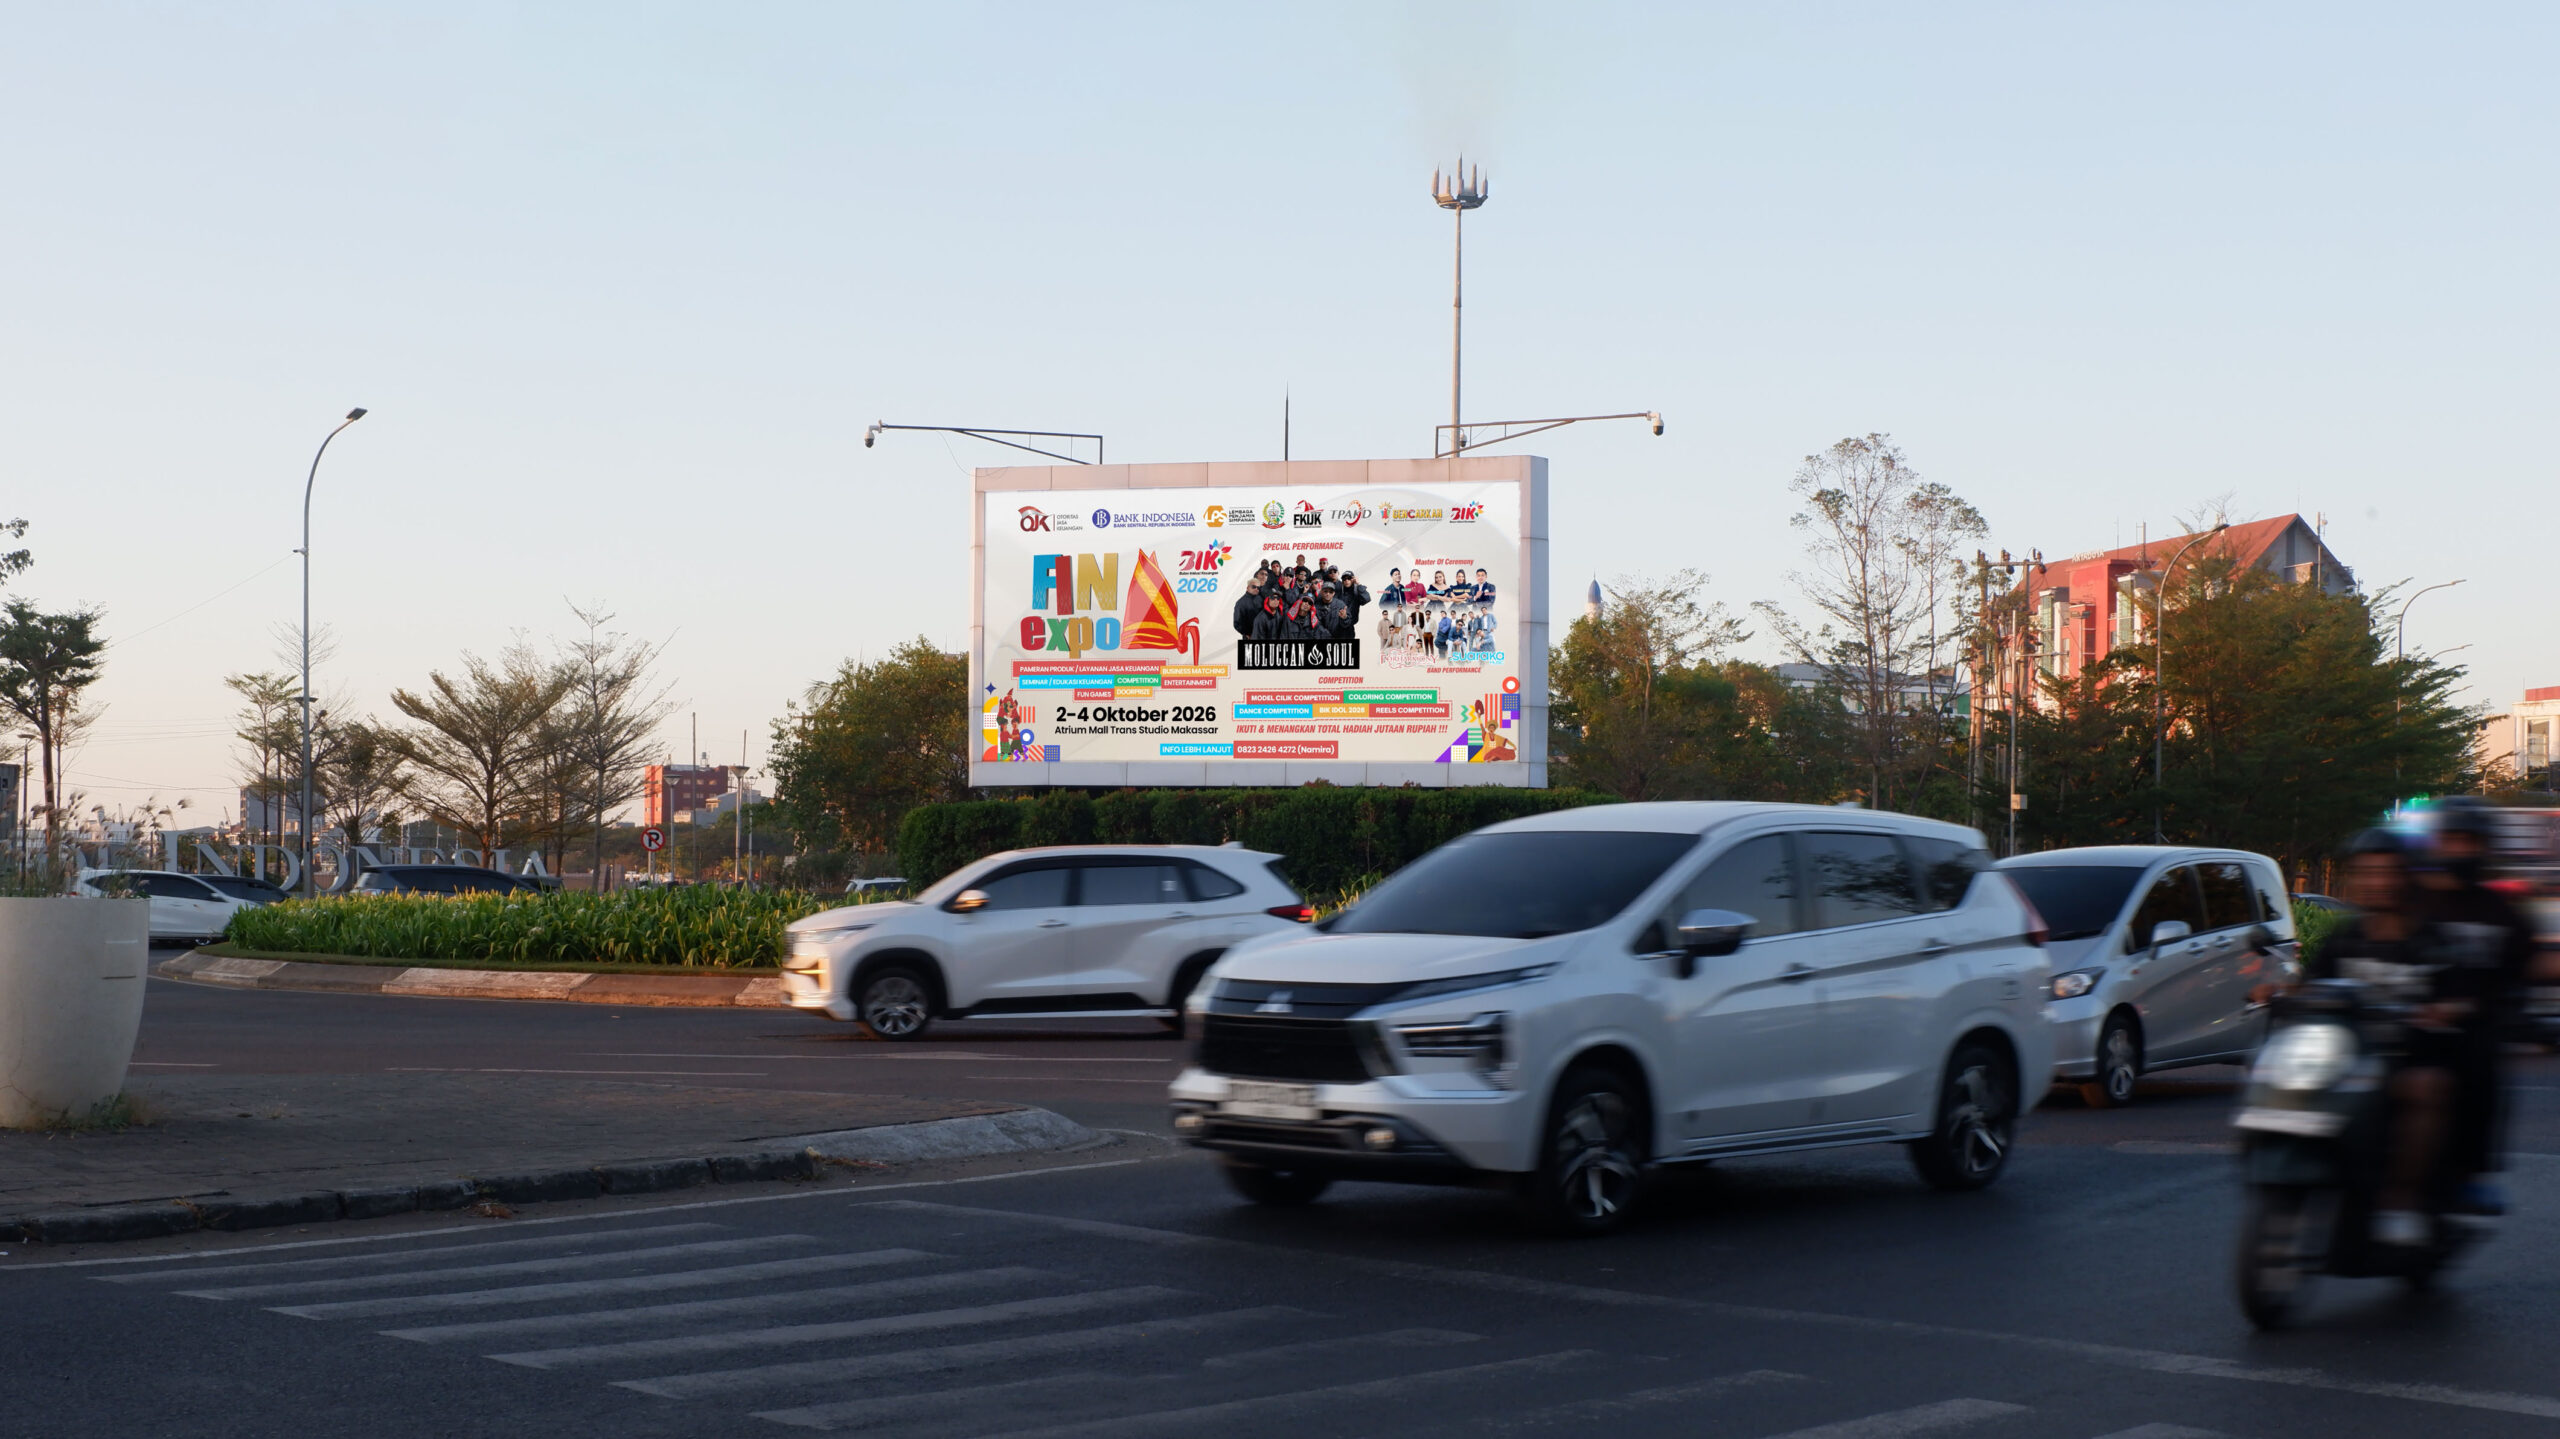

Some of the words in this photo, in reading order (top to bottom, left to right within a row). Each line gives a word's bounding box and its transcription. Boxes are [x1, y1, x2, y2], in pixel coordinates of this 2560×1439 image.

[1113, 513, 1140, 523] BANK
[1142, 512, 1196, 522] INDONESIA
[1204, 509, 1228, 522] LPS
[1330, 507, 1372, 520] TPAKD
[1392, 508, 1443, 519] GENCARKAN
[1450, 507, 1476, 520] BIK
[1020, 514, 1051, 532] OJK
[1262, 542, 1290, 551] SPECIAL
[1292, 541, 1344, 551] PERFORMANCE
[1179, 550, 1220, 571] BIK
[1415, 558, 1436, 566] Master
[1445, 558, 1474, 566] Ceremony
[1031, 552, 1119, 616] FIN
[1177, 577, 1218, 593] 2026
[1020, 615, 1121, 659] expo
[1244, 643, 1305, 667] MOLUCCAN
[1326, 643, 1355, 667] SOUL
[1318, 676, 1364, 685] COMPETITION
[1116, 688, 1151, 696] DOORPRIZE
[1348, 693, 1385, 701] COLORING
[1093, 706, 1169, 722] Oktober
[1172, 706, 1216, 722] 2026
[1054, 726, 1087, 734] Atrium
[1088, 726, 1109, 734] Mall
[1110, 726, 1137, 734] Trans
[1139, 725, 1169, 734] Studio
[1170, 725, 1219, 734] Makassar
[1236, 725, 1258, 733] IKUTI
[1258, 725, 1265, 733] &
[1267, 725, 1316, 733] MENANGKAN
[1318, 725, 1341, 733] TOTAL
[1342, 725, 1373, 733] HADIAH
[1374, 725, 1406, 733] JUTAAN
[1407, 725, 1437, 733] RUPIAH
[1438, 725, 1448, 733] !!!
[1237, 746, 1257, 754] 0823
[1257, 746, 1277, 754] 2426
[1278, 746, 1296, 754] 4272
[1297, 745, 1335, 755] (Namira)
